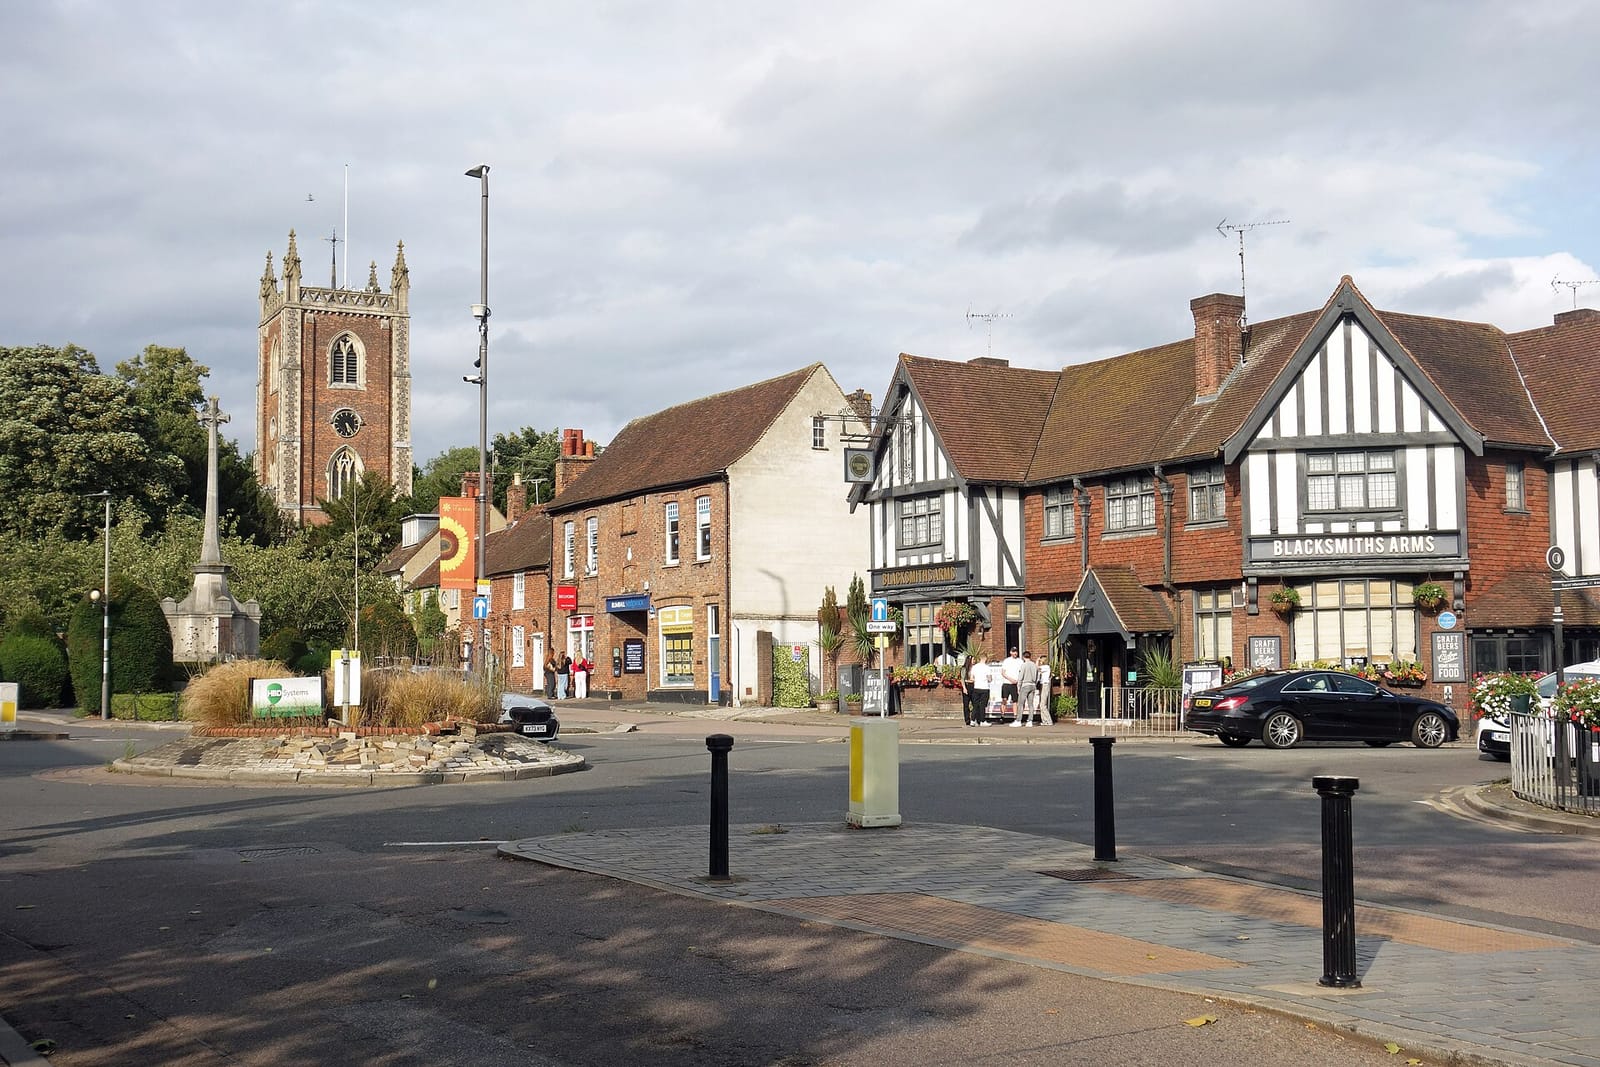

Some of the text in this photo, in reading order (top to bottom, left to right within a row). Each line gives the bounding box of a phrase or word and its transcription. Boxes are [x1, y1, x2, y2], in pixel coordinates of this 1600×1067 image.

[1273, 536, 1435, 555] BLACKSMITHS ARMS
[882, 566, 956, 586] BLACKSMITHS ARMS
[1254, 640, 1276, 648] CRAFT
[1254, 647, 1275, 655] BEERS
[1438, 668, 1460, 678] FOOD
